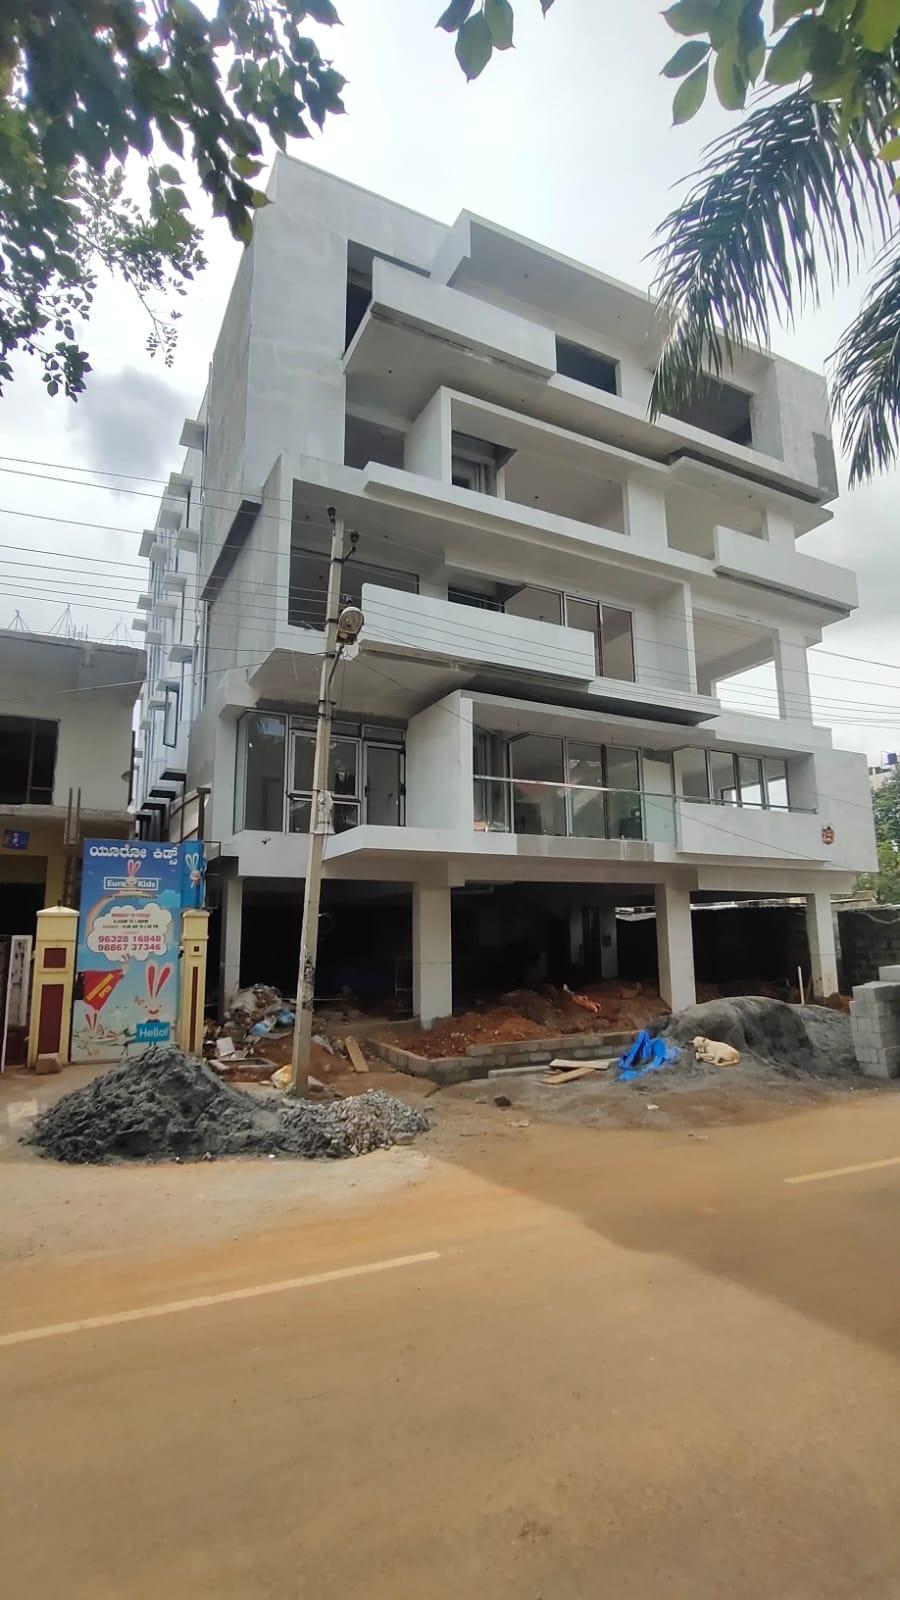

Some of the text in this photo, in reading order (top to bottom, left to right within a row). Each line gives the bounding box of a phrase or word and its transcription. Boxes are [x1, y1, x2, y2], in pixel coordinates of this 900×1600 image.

[137, 880, 156, 889] Kids
[98, 935, 161, 943] 96328 16848
[138, 1027, 168, 1038] Hello!
